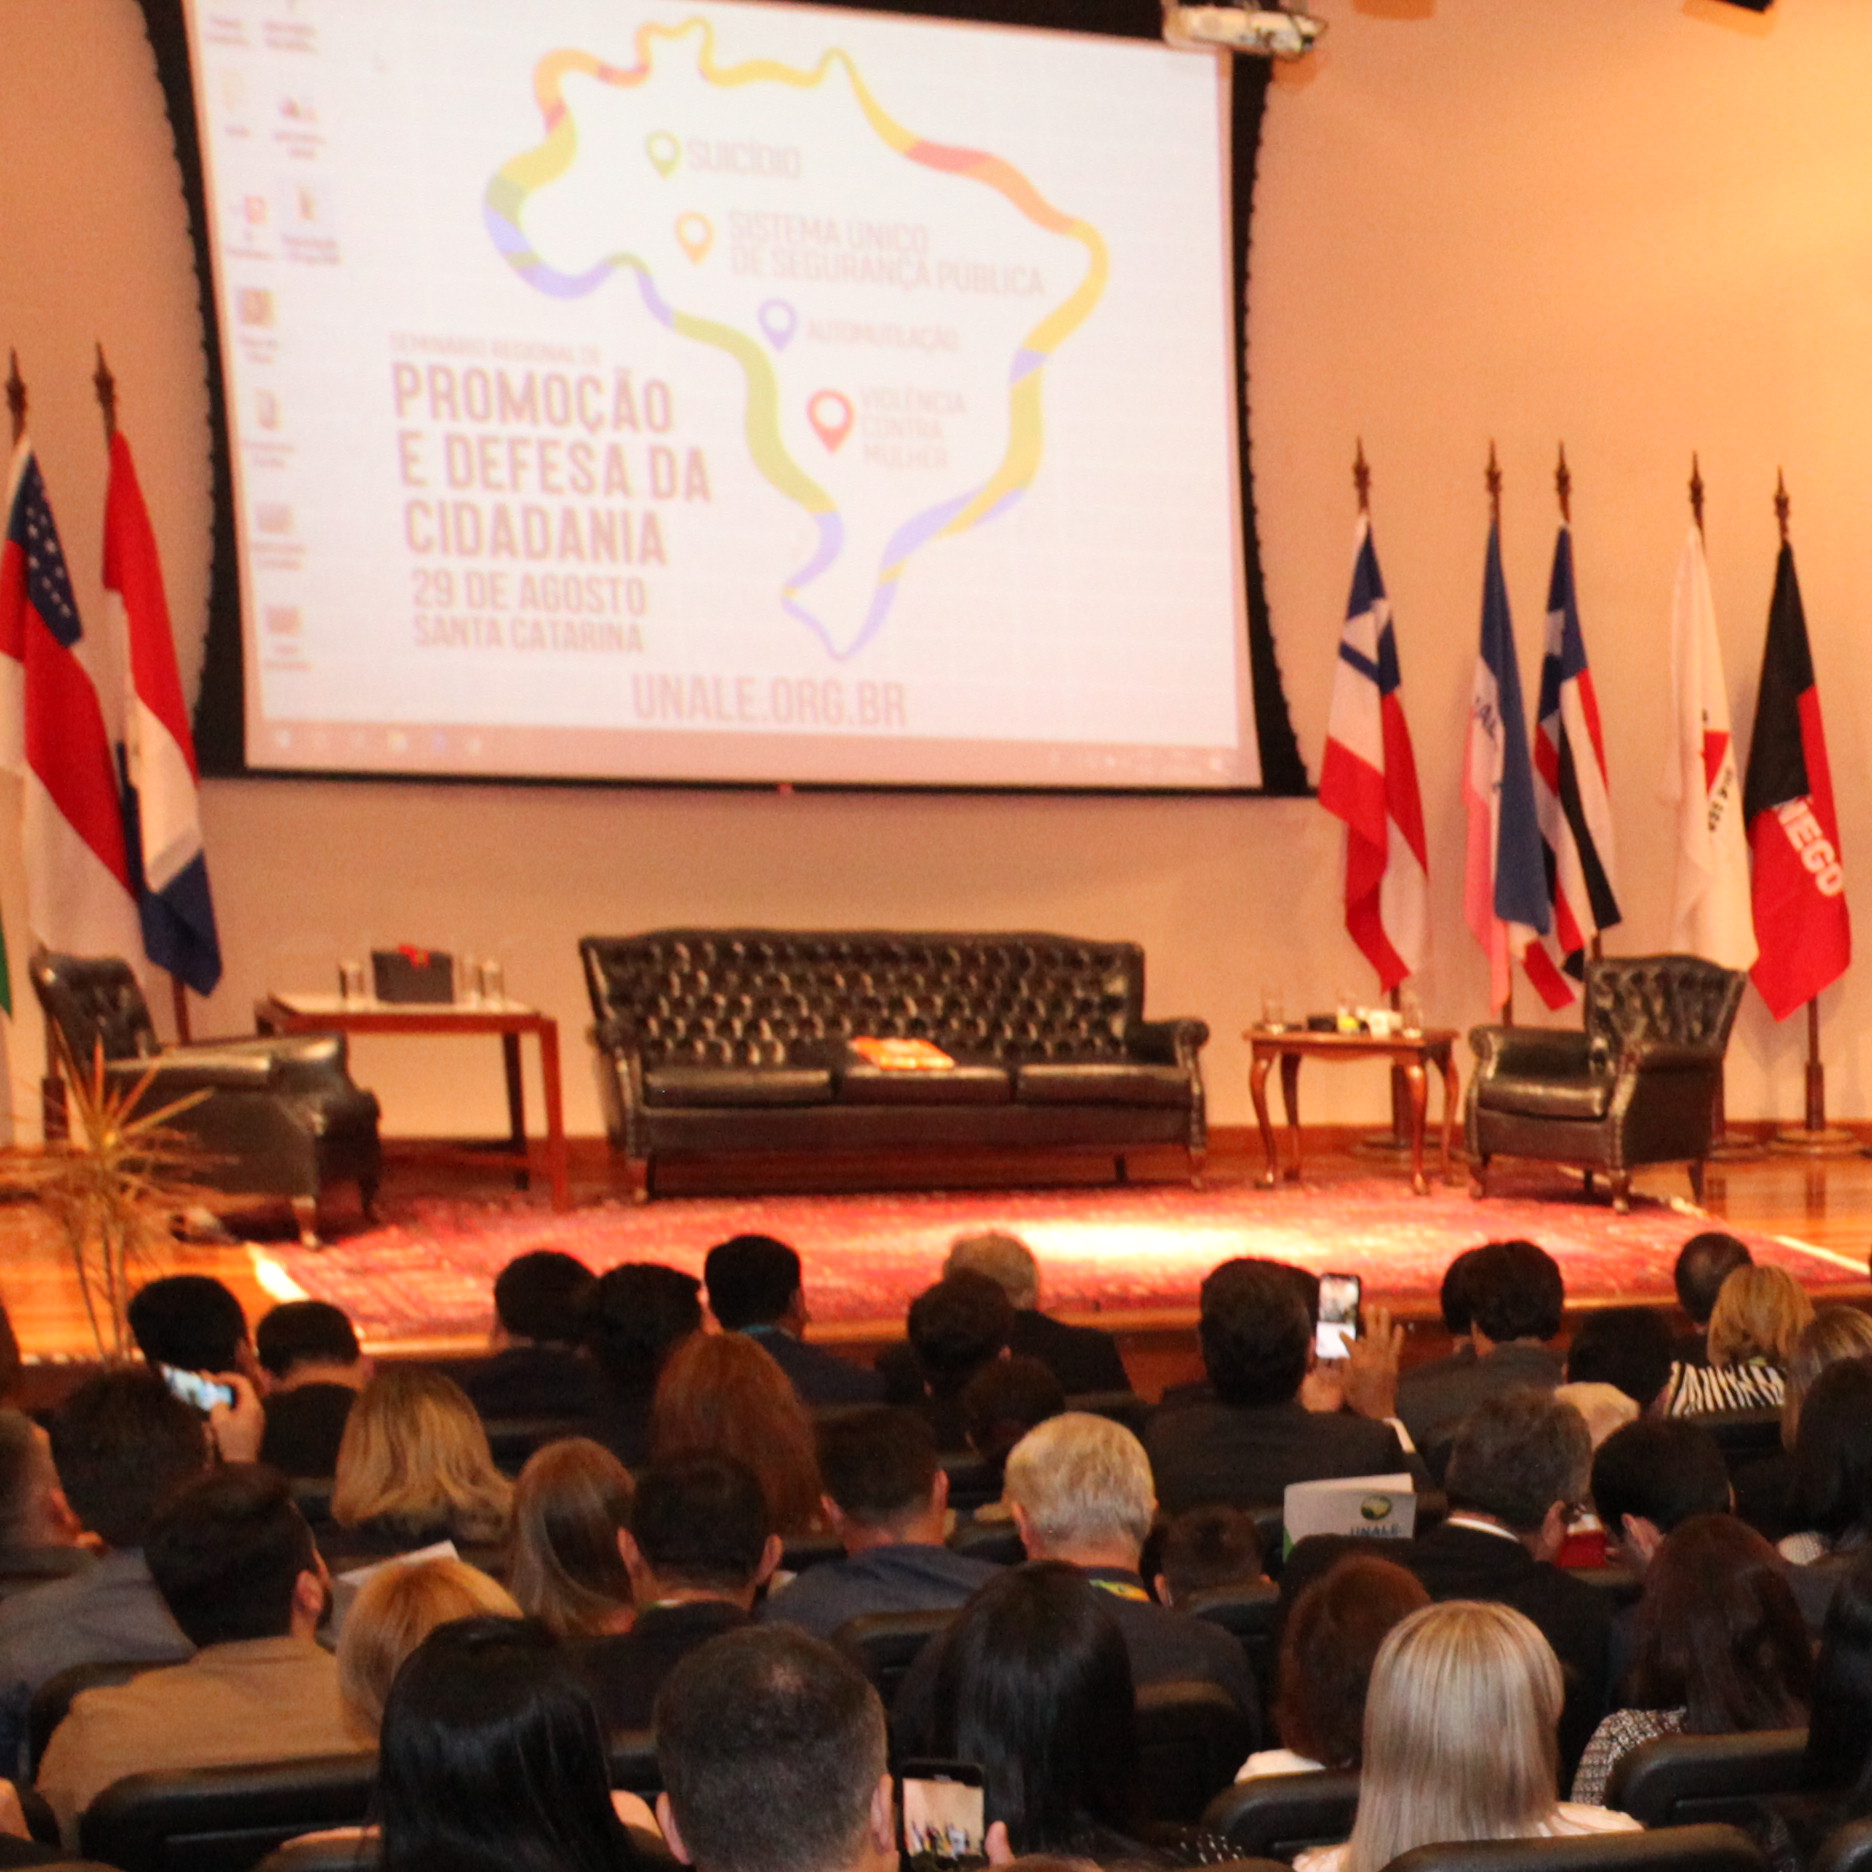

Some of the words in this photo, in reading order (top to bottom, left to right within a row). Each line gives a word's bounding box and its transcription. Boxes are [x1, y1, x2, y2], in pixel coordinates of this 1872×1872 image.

[391, 361, 674, 436] PROMOÇÃO
[398, 430, 427, 488] E
[444, 434, 634, 499] DEFESA
[648, 444, 712, 502] DA
[404, 499, 669, 567] CIDADANIA
[411, 567, 455, 610] 29
[465, 569, 511, 612] DE
[518, 573, 648, 617] AGOSTO
[411, 614, 504, 650] SANTA
[510, 618, 645, 654] CATARINA
[630, 674, 909, 728] UNALE.ORG.BR
